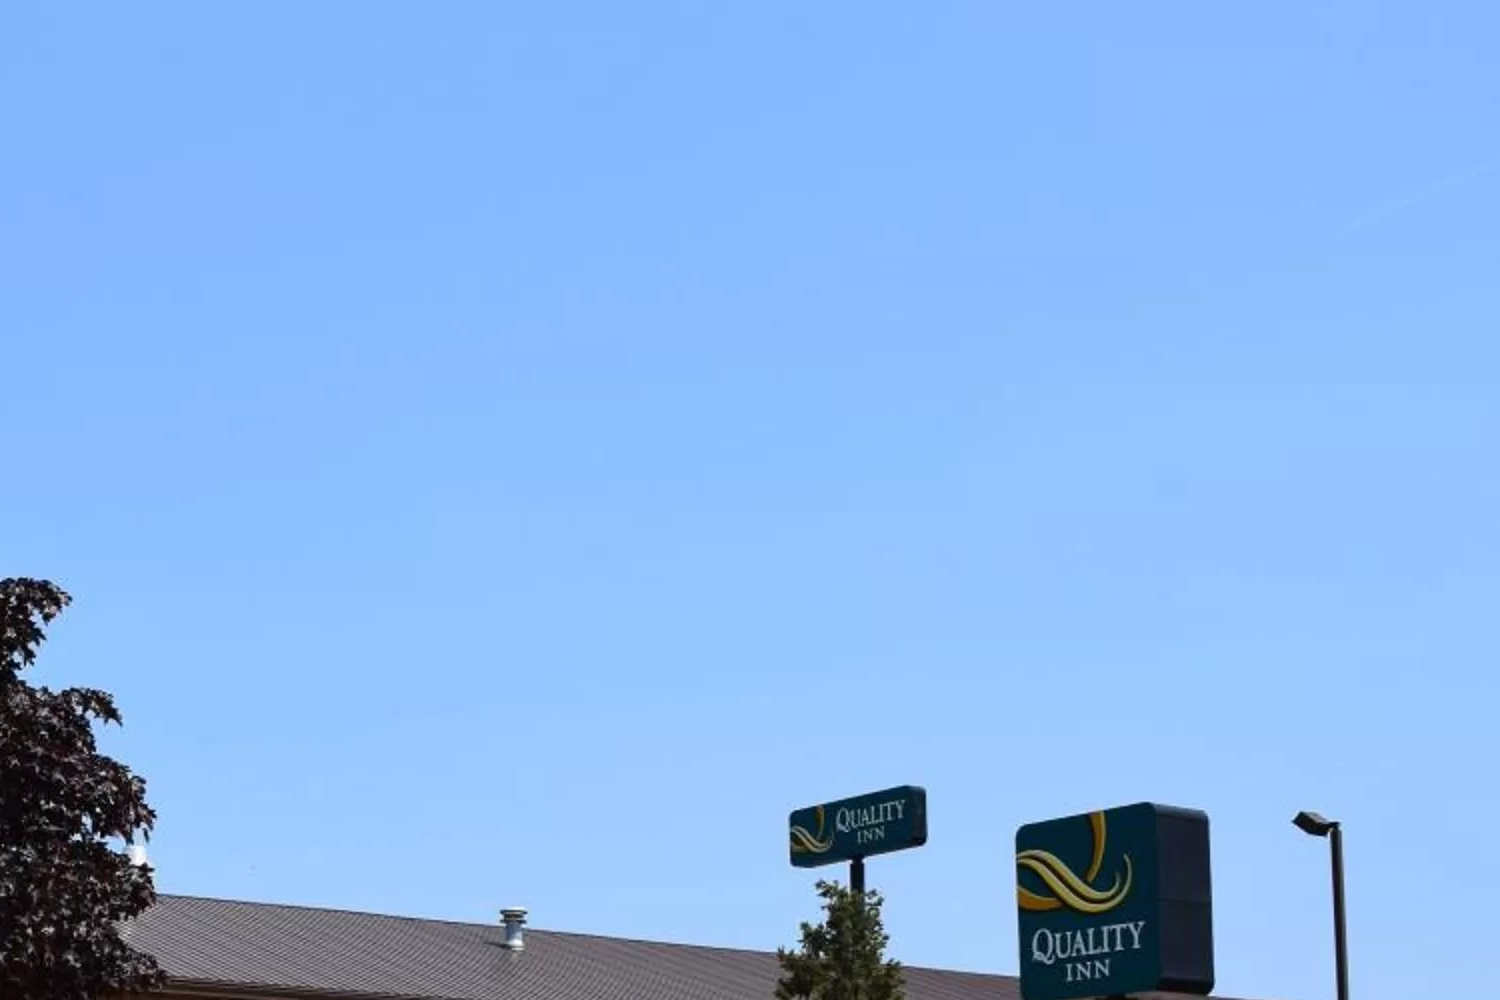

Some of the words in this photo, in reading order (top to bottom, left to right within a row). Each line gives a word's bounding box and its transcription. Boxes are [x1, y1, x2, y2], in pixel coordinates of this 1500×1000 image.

[836, 800, 905, 832] QUALITY
[857, 826, 885, 844] INN
[1032, 921, 1145, 964] QUALITY
[1065, 960, 1110, 982] INN
